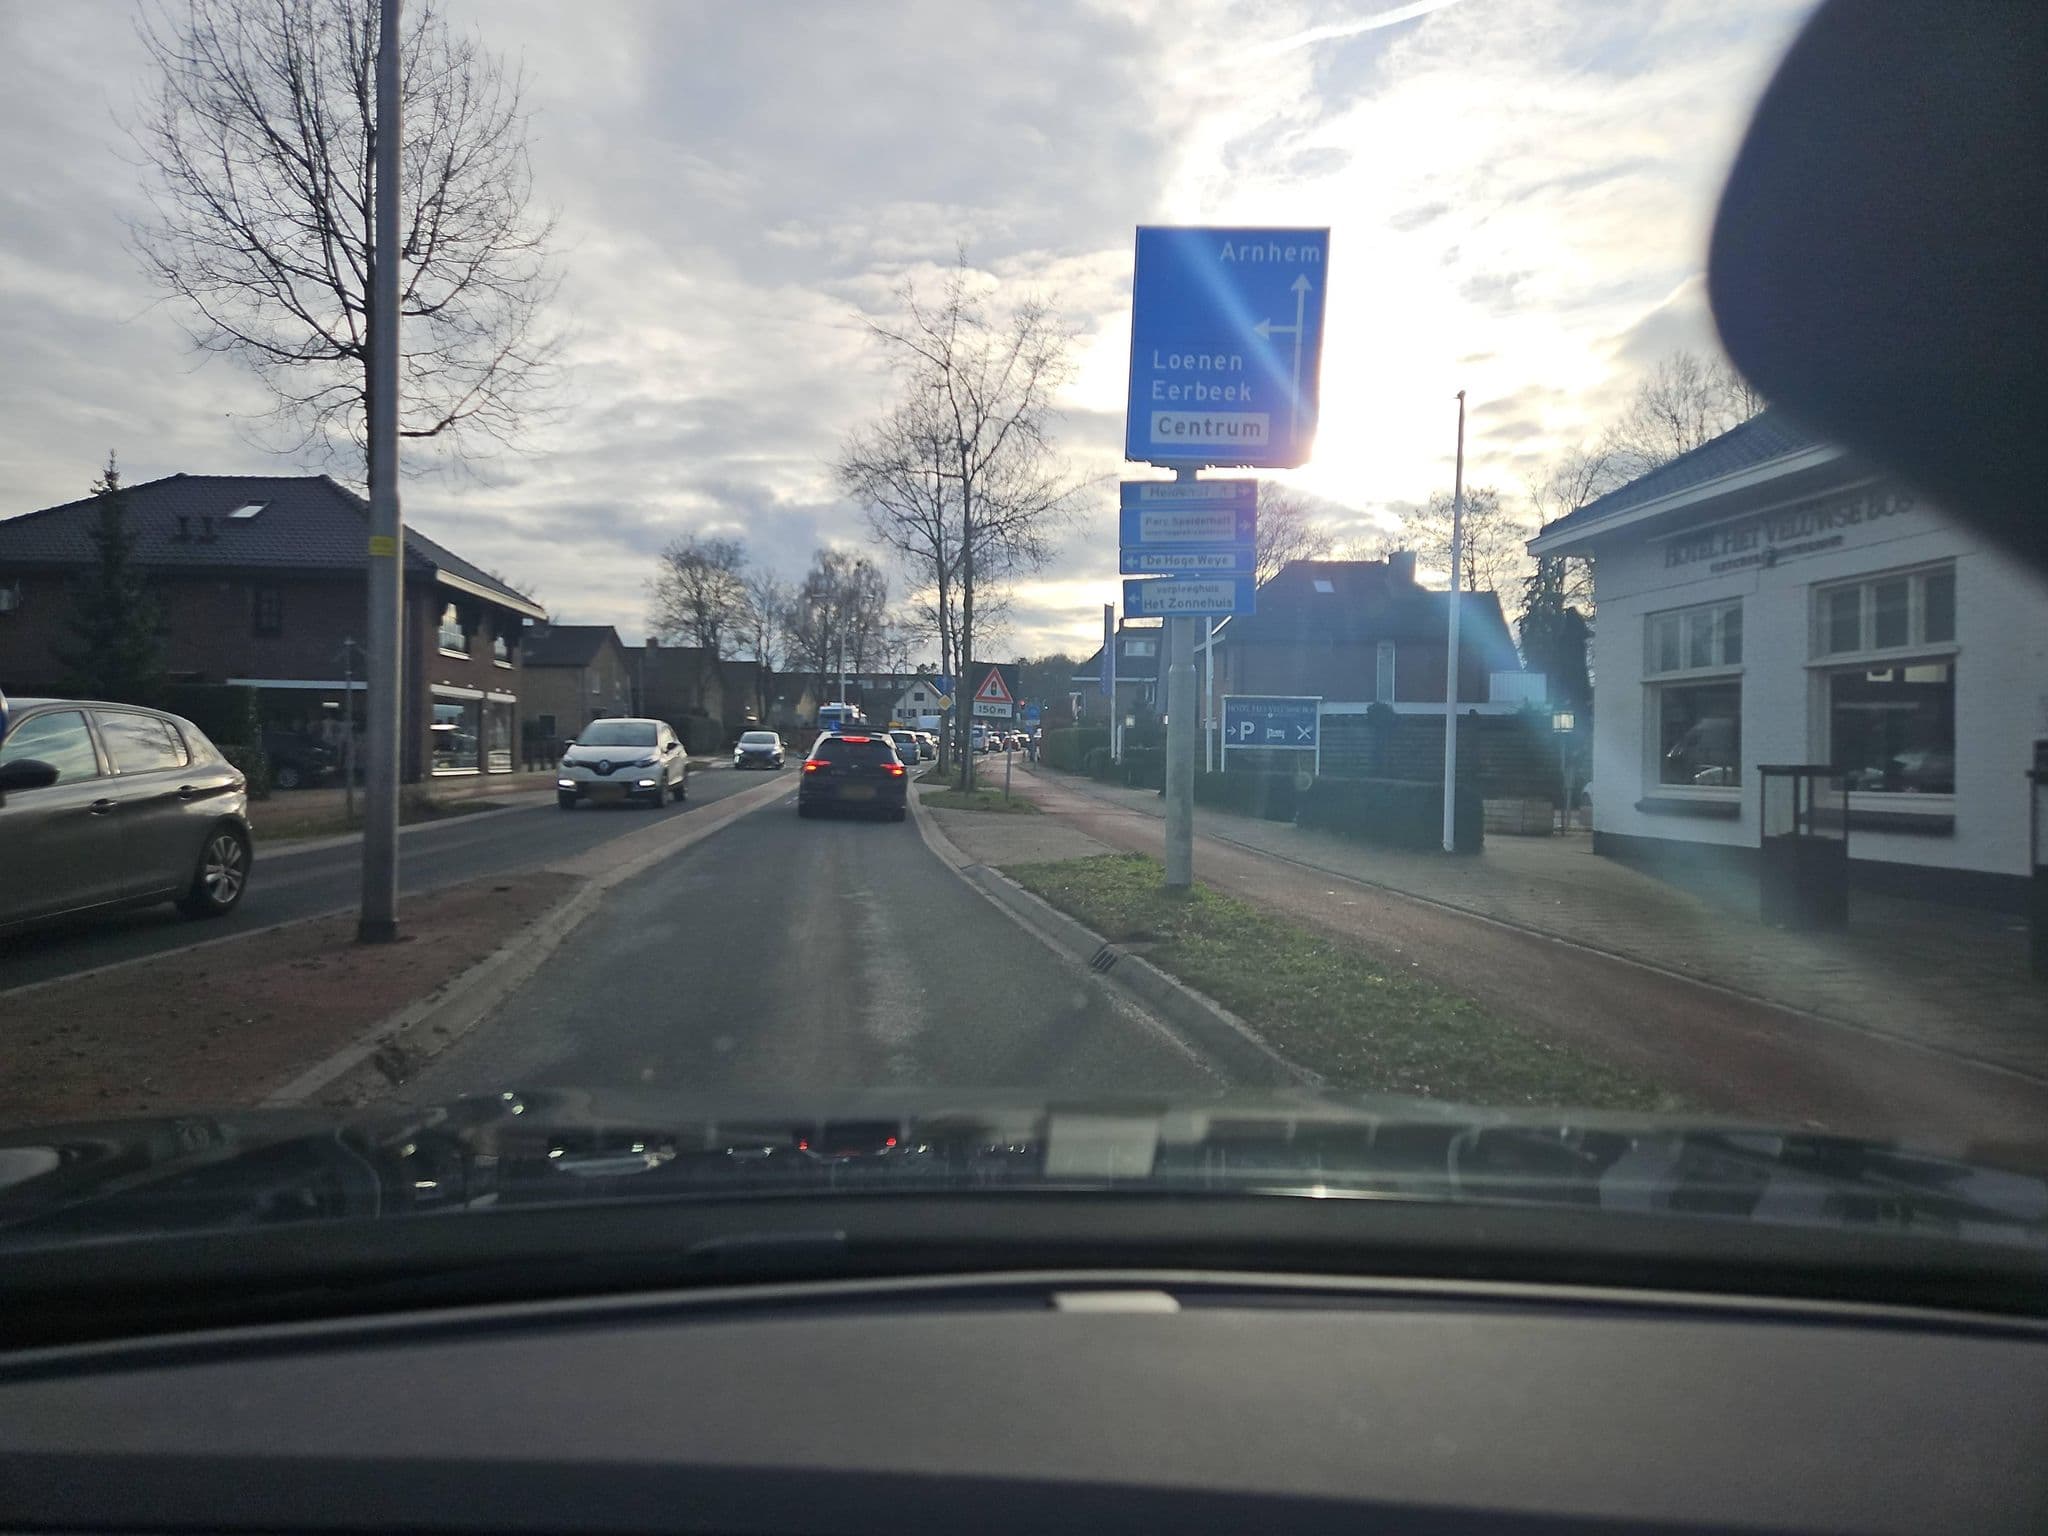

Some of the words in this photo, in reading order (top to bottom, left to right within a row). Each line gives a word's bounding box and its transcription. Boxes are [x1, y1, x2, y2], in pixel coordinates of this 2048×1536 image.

[1219, 241, 1320, 262] Arnhem
[1152, 350, 1243, 370] Loenen
[1151, 380, 1252, 401] Eerbeek
[1157, 416, 1262, 437] Centrum
[1146, 556, 1162, 566] De
[1165, 556, 1196, 568] Hoge
[1143, 599, 1165, 609] Het
[1168, 598, 1233, 610] Zonnehuis
[978, 705, 997, 714] 150
[997, 707, 1007, 715] m
[1240, 721, 1255, 741] P
